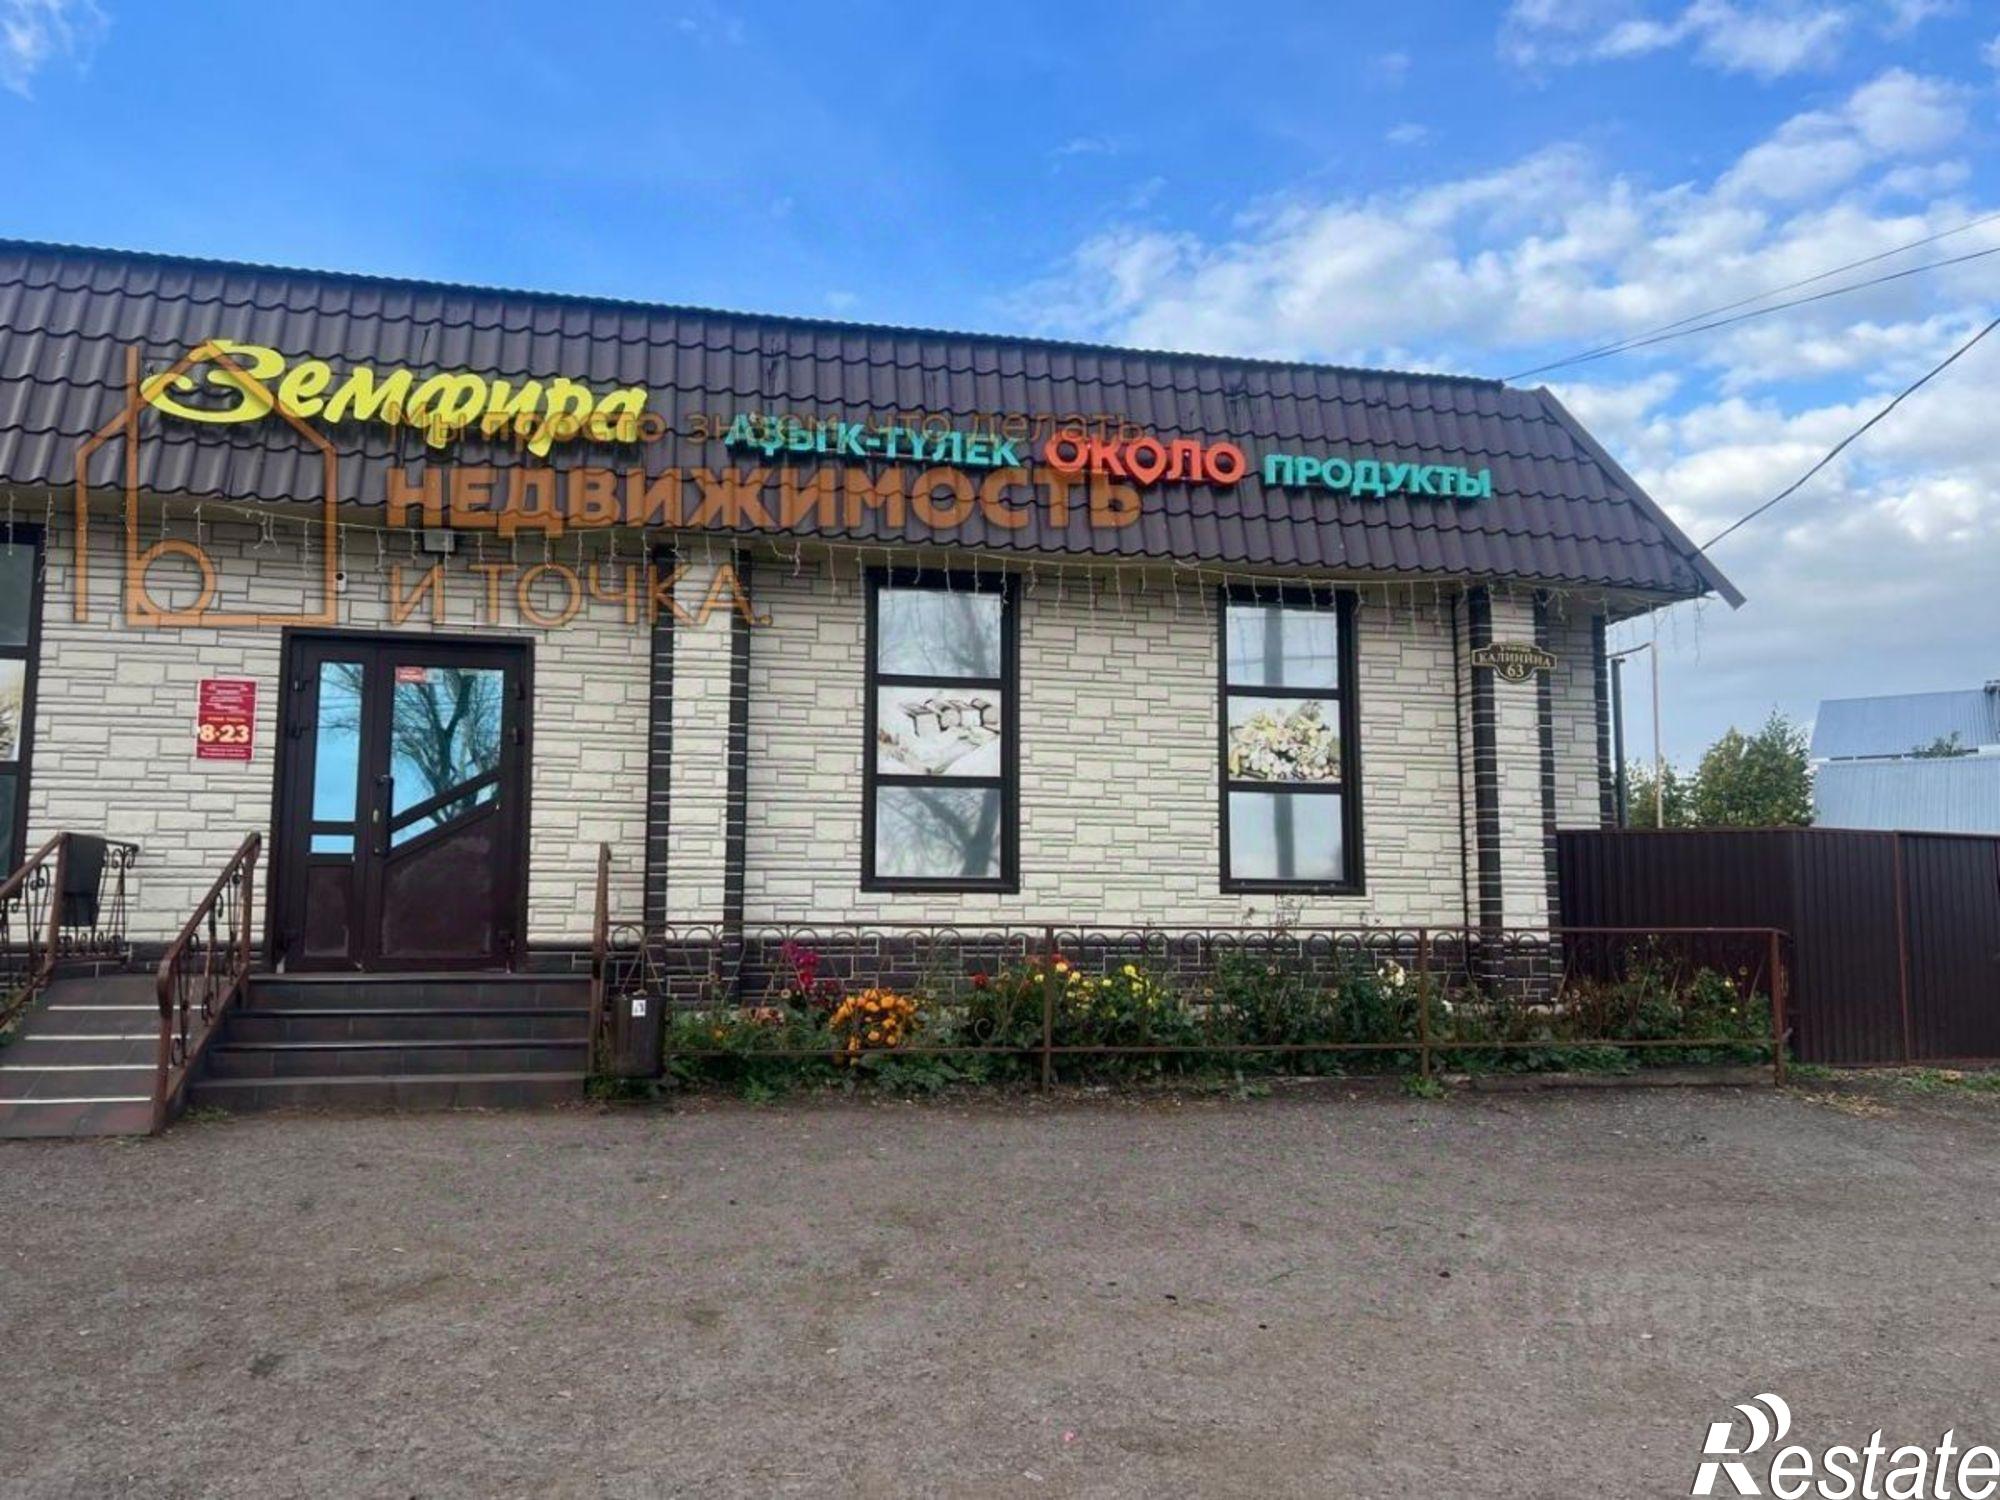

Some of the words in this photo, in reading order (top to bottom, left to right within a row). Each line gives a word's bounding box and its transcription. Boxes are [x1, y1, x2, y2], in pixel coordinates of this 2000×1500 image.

[140, 339, 648, 458] Земфира
[1045, 432, 1247, 486] ОКОЛО
[1263, 452, 1492, 501] ПРОДУКТЫ
[1479, 653, 1551, 667] КАЛИНИНА
[1507, 664, 1524, 677] 63
